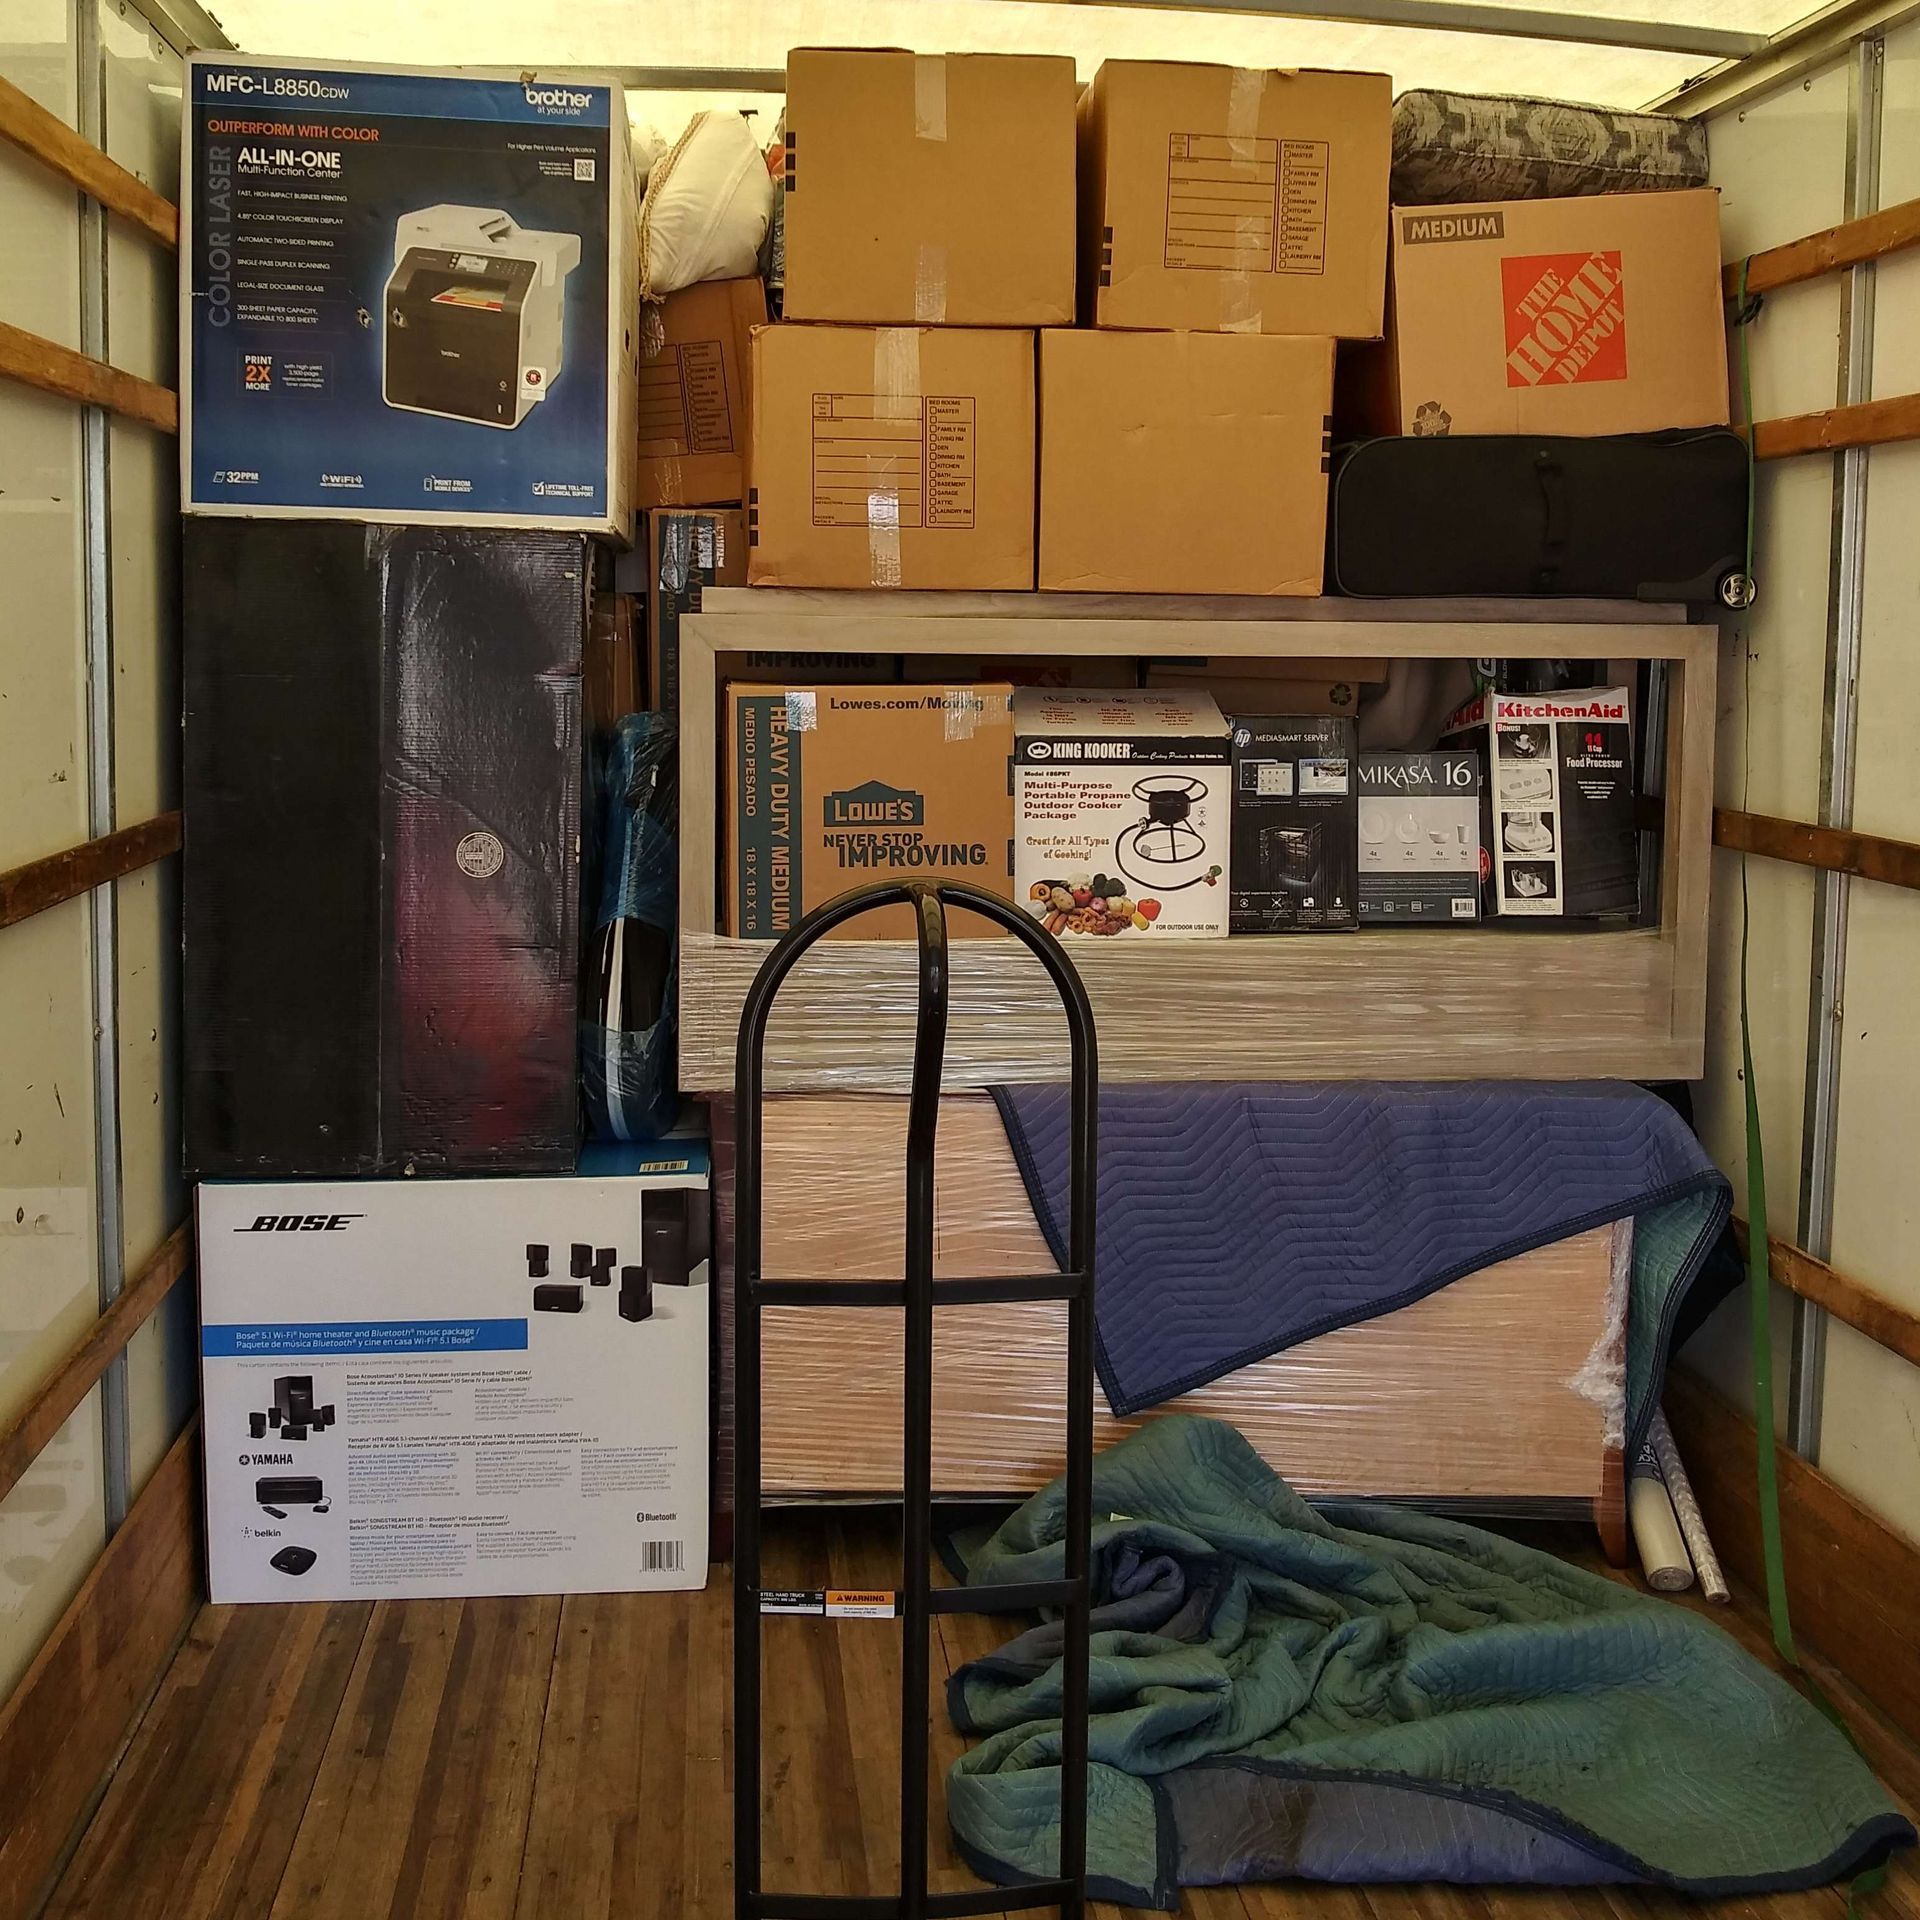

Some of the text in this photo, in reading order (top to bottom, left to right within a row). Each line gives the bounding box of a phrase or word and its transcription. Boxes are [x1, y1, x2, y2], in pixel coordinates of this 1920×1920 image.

[206, 74, 350, 99] MFC-L8850CDW
[526, 88, 593, 108] brother
[546, 107, 563, 116] your
[565, 108, 581, 116] side
[208, 119, 380, 141] OUTPERFORM WITH COLOR
[516, 143, 533, 152] Higher
[545, 144, 564, 152] Volume
[565, 145, 596, 154] Applications
[237, 147, 341, 169] ALL-IN-ONE
[238, 164, 341, 179] Multi-Function Center
[253, 191, 293, 199] HIGH-IMPACT
[294, 193, 320, 201] BUSINESS
[321, 194, 348, 202] PRINTING
[252, 213, 275, 221] COLOR
[275, 215, 319, 223] TOUCHSCREEN
[320, 217, 343, 225] DISPLAY
[1410, 216, 1498, 240] MEDIUM
[208, 145, 231, 327] COLOR LASER
[237, 236, 272, 244] AUTOMATIC
[307, 239, 334, 247] PRINTING
[237, 258, 330, 269] SINGLE-PASS DUPLEX SCANNING
[269, 283, 304, 291] DOCUMENT
[1516, 267, 1566, 322] THE
[237, 313, 275, 321] EXPANDABLE
[1506, 252, 1622, 385] HOME
[1554, 299, 1625, 383] DEPOT
[245, 355, 273, 365] PRINT
[245, 366, 271, 382] 2X
[245, 382, 270, 391] MORE
[1497, 702, 1623, 718] KitchenAid
[1235, 730, 1329, 747] hp MEDIASMART SERVER
[1053, 742, 1131, 759] KING KOOKER
[1593, 745, 1603, 753] Cup
[744, 707, 756, 817] MEDIO PESADO
[1566, 757, 1623, 768] Food Processor
[1442, 760, 1472, 787] 16
[1024, 781, 1113, 790] Multi-Purpose
[1024, 791, 1131, 801] Portable Propane
[834, 798, 914, 822] LOWE'S
[1024, 801, 1122, 809] Outdoor Cooker
[770, 706, 790, 932] HEAVY DUTY MEDIUM
[1024, 811, 1077, 820] Package
[823, 833, 924, 848] NEVER STOP
[1026, 836, 1109, 847] Great for All Types
[838, 843, 986, 868] IMPROVING
[746, 847, 756, 930] 18 X 18 X 16
[249, 1215, 353, 1232] BOSE
[236, 1332, 255, 1340] Bose
[273, 1331, 294, 1339] Wi-Fi
[323, 1330, 352, 1338] theater
[354, 1329, 370, 1337] and
[371, 1328, 411, 1337] Bluetooth
[416, 1328, 441, 1336] music
[442, 1327, 474, 1337] package
[236, 1340, 270, 1349] Paquete
[271, 1339, 280, 1347] de
[282, 1338, 311, 1347] música
[312, 1337, 353, 1347] Bluetooth
[358, 1339, 363, 1347] y
[364, 1337, 381, 1346] cine
[413, 1336, 435, 1345] Wi-Fi
[451, 1335, 470, 1344] Bose
[252, 1454, 294, 1465] YAMAHA
[645, 1513, 677, 1521] Bluetooth
[254, 1529, 281, 1537] belkin
